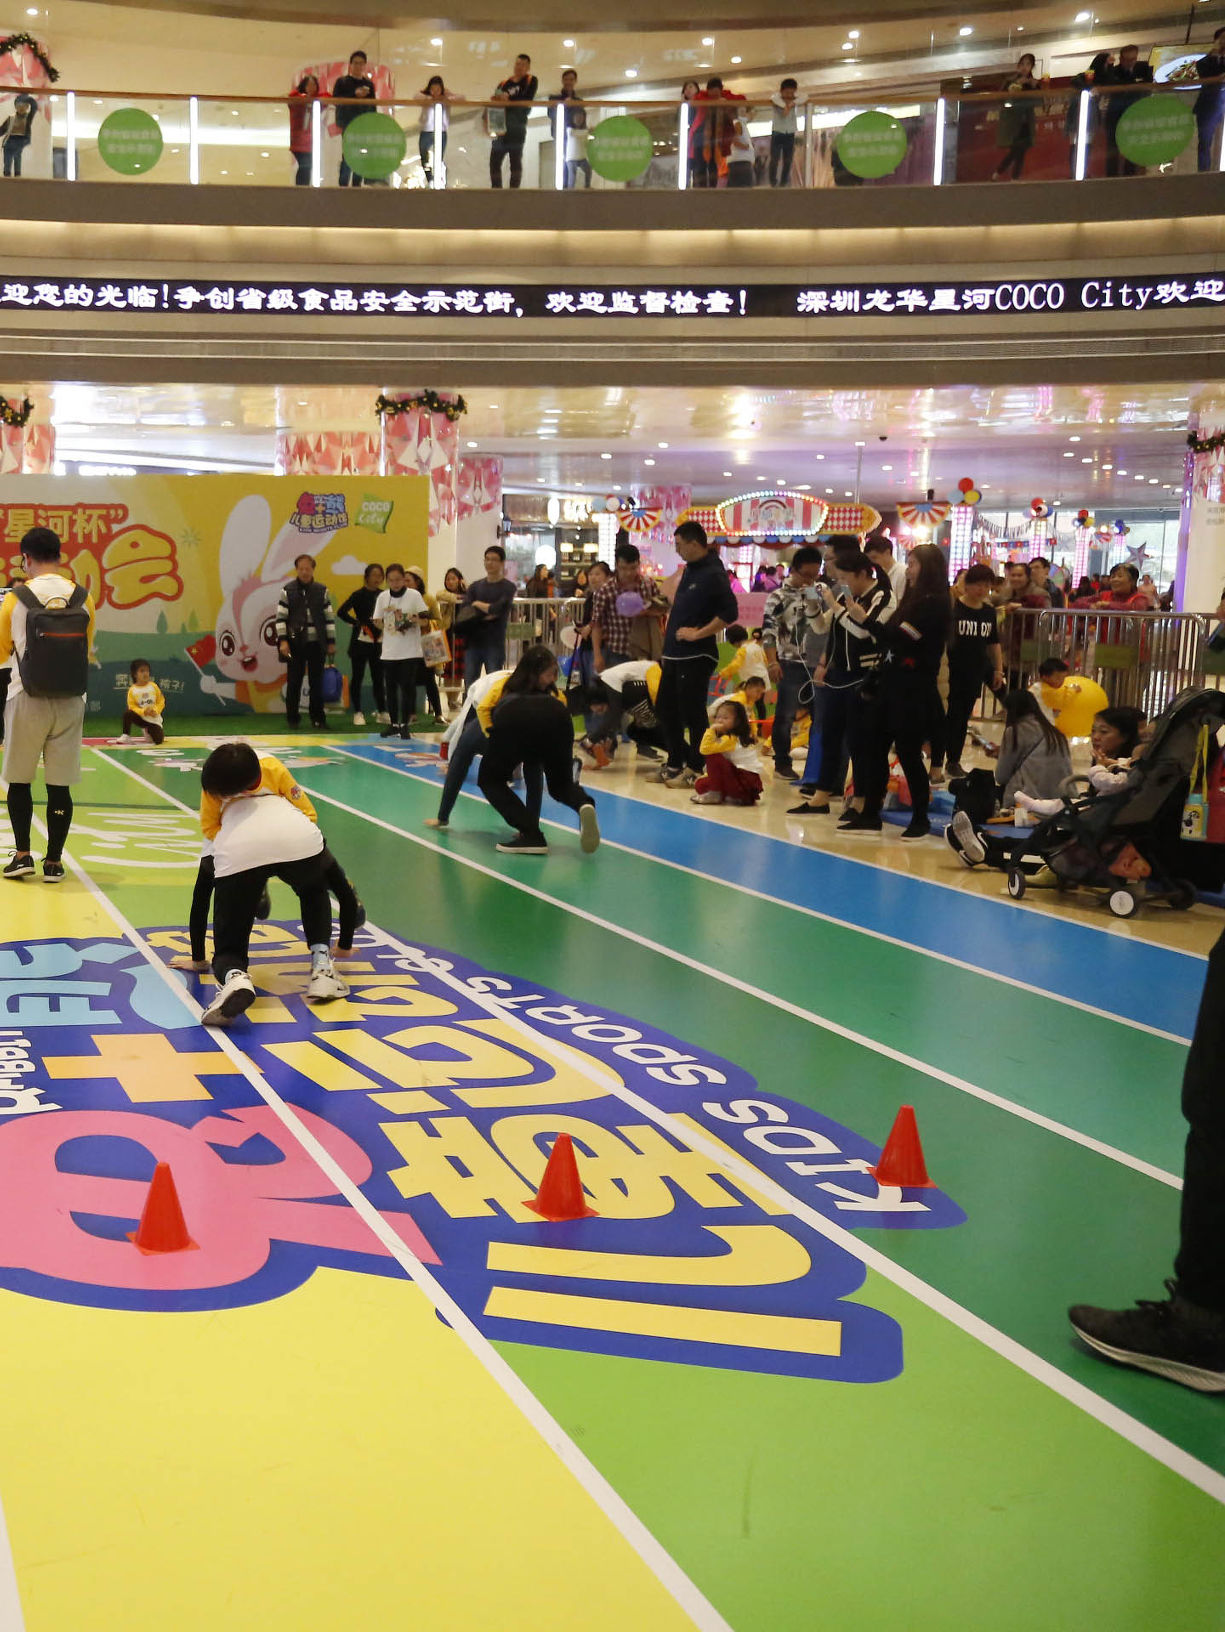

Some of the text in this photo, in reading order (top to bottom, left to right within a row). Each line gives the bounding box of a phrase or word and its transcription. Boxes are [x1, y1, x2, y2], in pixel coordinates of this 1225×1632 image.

[796, 283, 1065, 314] 深圳龙华星河COCO
[362, 501, 390, 512] COCO
[463, 974, 729, 1088] SPORTS
[702, 1098, 933, 1213] KIDS
